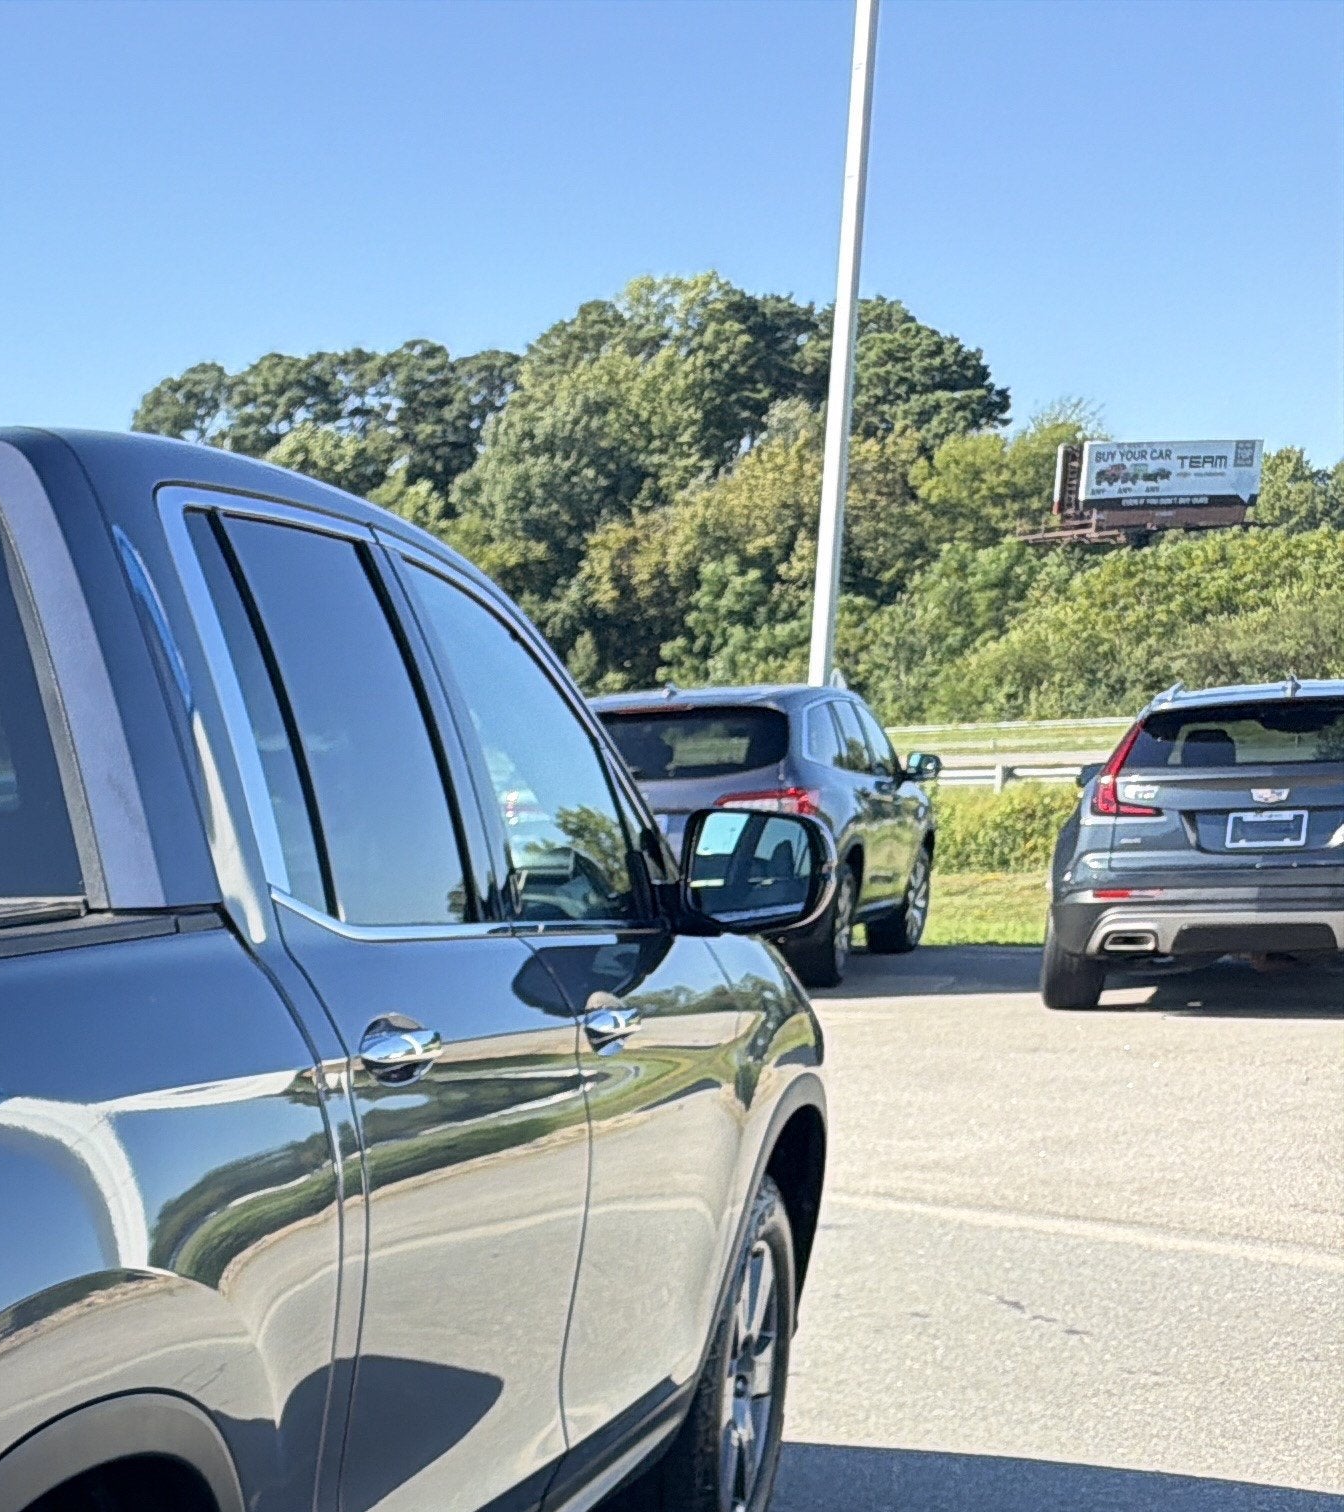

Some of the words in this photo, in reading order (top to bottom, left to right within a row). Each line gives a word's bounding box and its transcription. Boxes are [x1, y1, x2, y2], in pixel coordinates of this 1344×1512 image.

[1095, 450, 1116, 463] BUY
[1119, 449, 1148, 462] YOUR
[1150, 448, 1172, 461] CAR
[1177, 455, 1228, 469] TEAM
